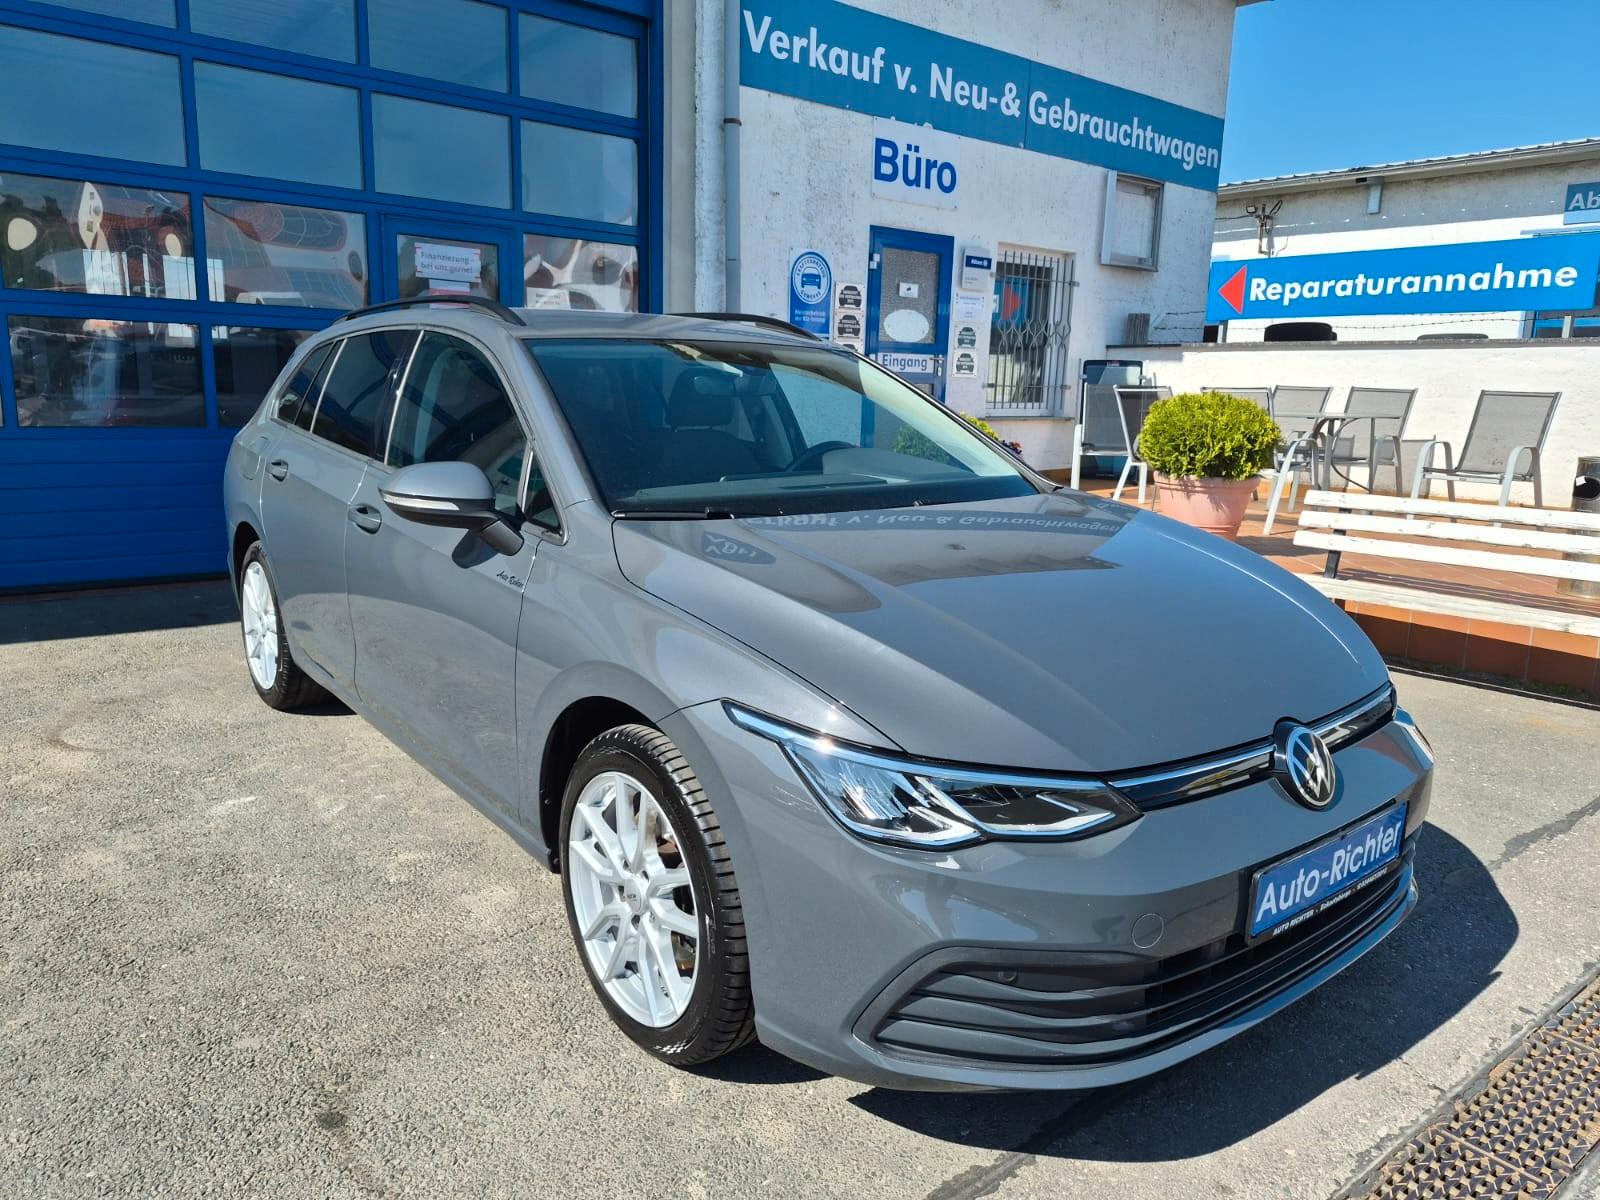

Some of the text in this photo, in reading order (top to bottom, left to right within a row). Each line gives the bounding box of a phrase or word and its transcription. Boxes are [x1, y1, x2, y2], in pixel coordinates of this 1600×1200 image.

[743, 10, 886, 85] Verkauf
[893, 63, 918, 94] v.
[1029, 91, 1219, 171] Gebrauchtwagen
[874, 137, 957, 194] Büro
[1250, 263, 1578, 305] Reparaturannahme
[882, 353, 928, 371] Eingang
[1255, 821, 1402, 922] Auto-Richter
